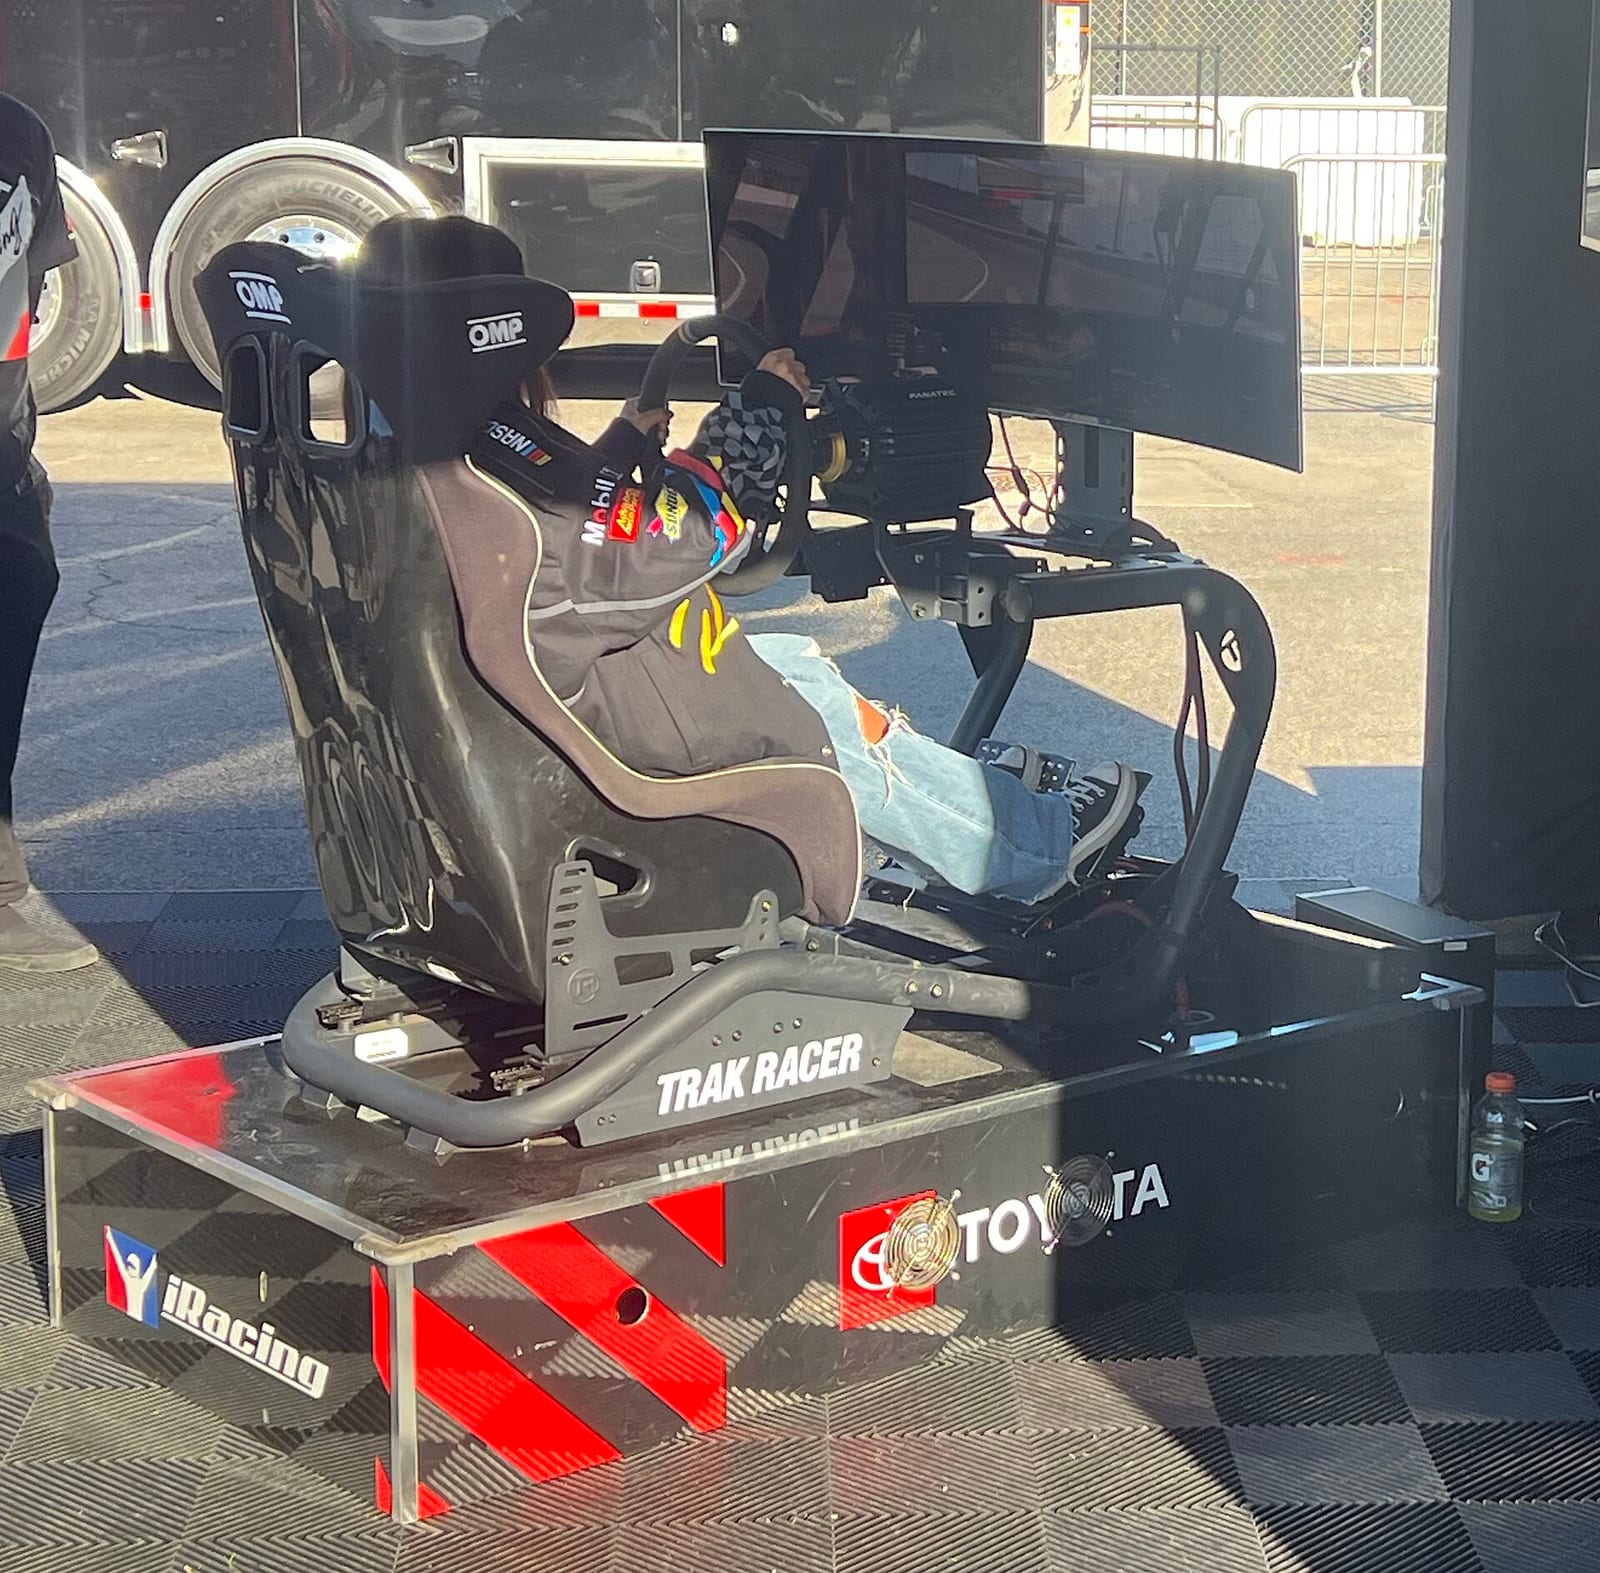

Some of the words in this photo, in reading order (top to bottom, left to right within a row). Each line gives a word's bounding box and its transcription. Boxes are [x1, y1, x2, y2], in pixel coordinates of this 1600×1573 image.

[236, 280, 284, 313] OMP
[36, 326, 91, 384] MICHE
[468, 317, 523, 347] OMP
[580, 478, 616, 546] Mobil
[657, 1055, 751, 1116] TRAK
[751, 1032, 864, 1095] RACER
[957, 1163, 1170, 1264] TOYTA
[161, 1273, 330, 1399] iRacing
